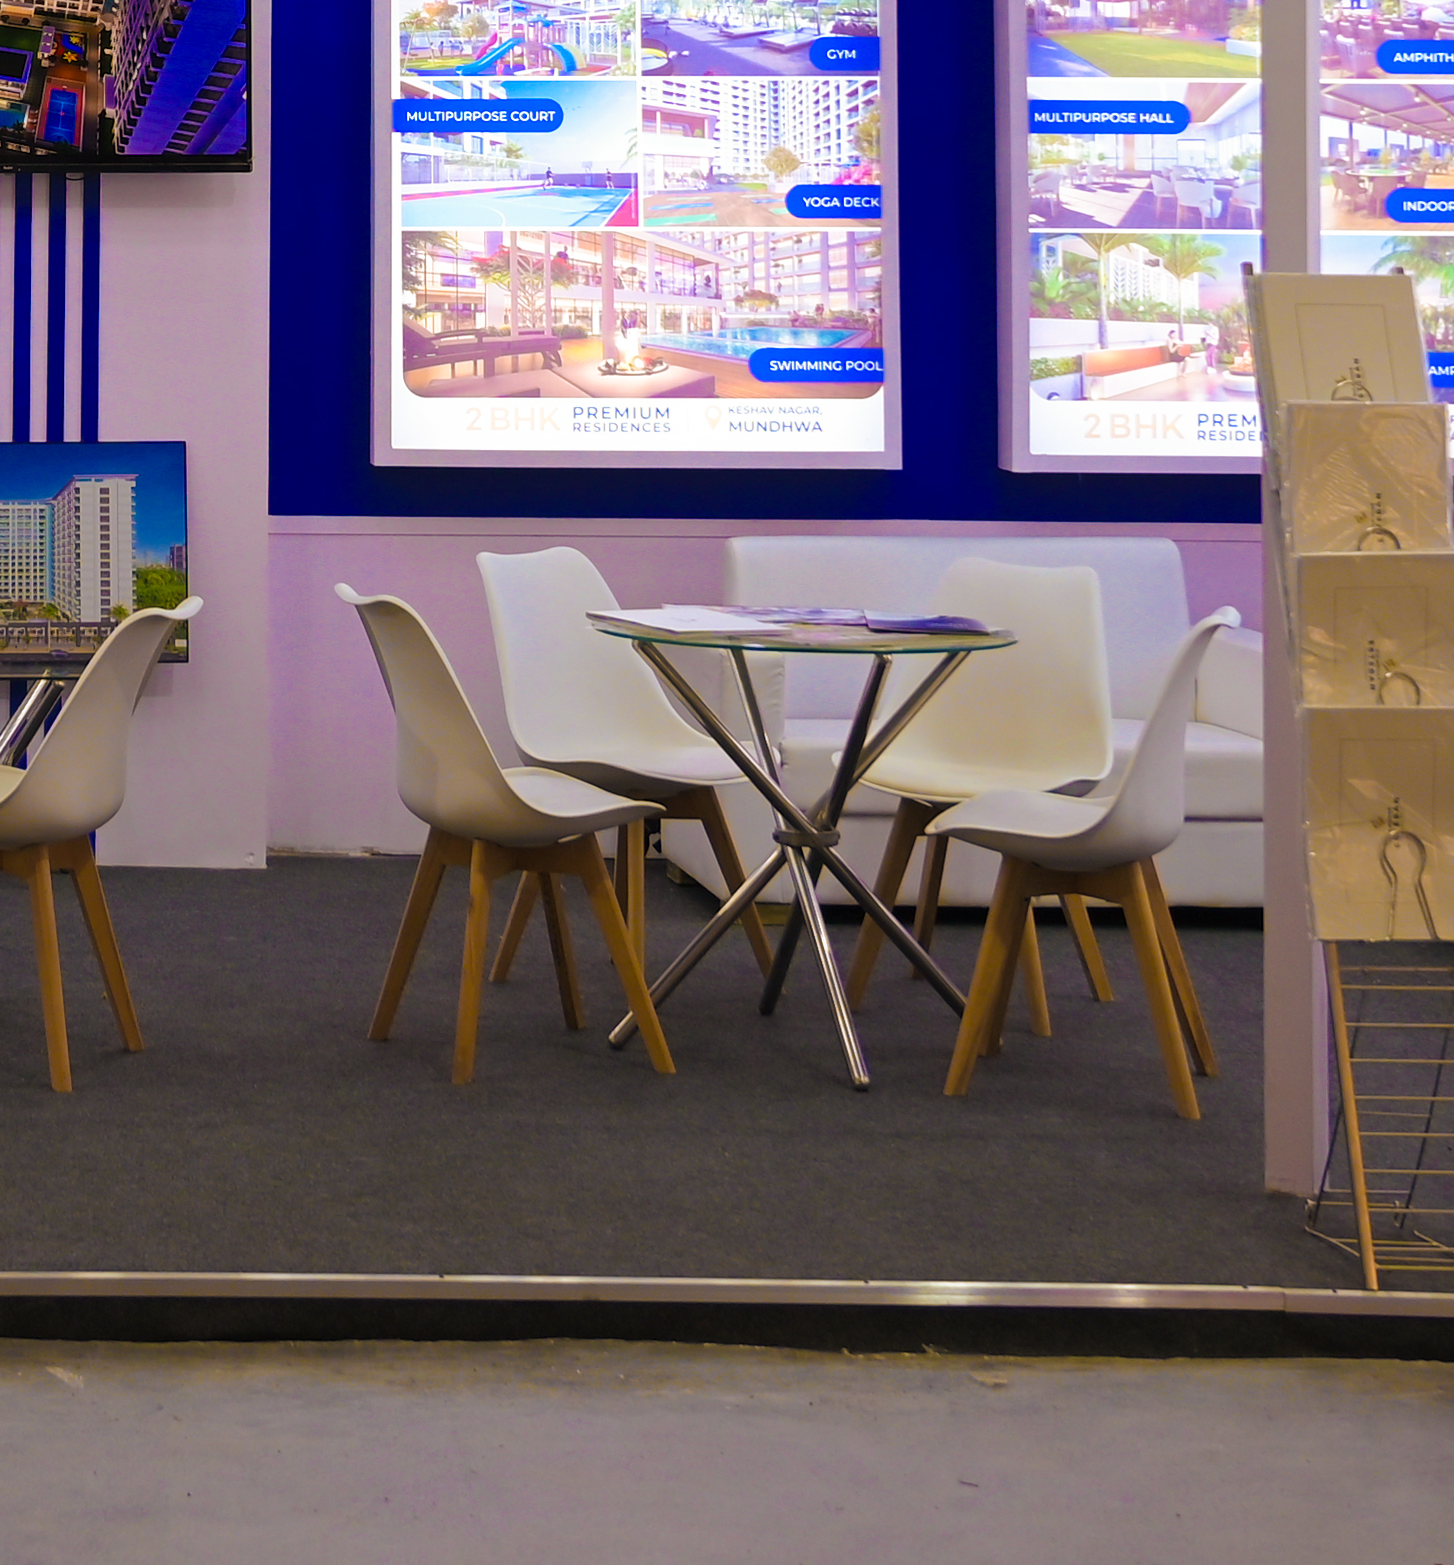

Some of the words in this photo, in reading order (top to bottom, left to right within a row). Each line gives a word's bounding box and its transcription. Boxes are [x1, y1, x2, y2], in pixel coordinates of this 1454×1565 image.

[827, 49, 856, 59] GYM
[407, 111, 507, 121] MULTIPURPOSE
[511, 111, 556, 121] COURT
[1035, 112, 1137, 123] MULTIPURPOSE
[1140, 113, 1174, 123] HALL
[803, 197, 840, 207] YOGA
[843, 196, 880, 208] DECK
[770, 360, 842, 371] SWIMMING
[845, 360, 883, 372] POOL
[574, 407, 669, 419] PREMIUM
[729, 406, 774, 414] KESHAV
[779, 406, 823, 416] NAGAR,
[1197, 414, 1257, 427] PREM
[573, 423, 670, 432] RESIDENCES
[730, 421, 822, 432] MUNDHWA
[1197, 430, 1264, 441] RESIDE
